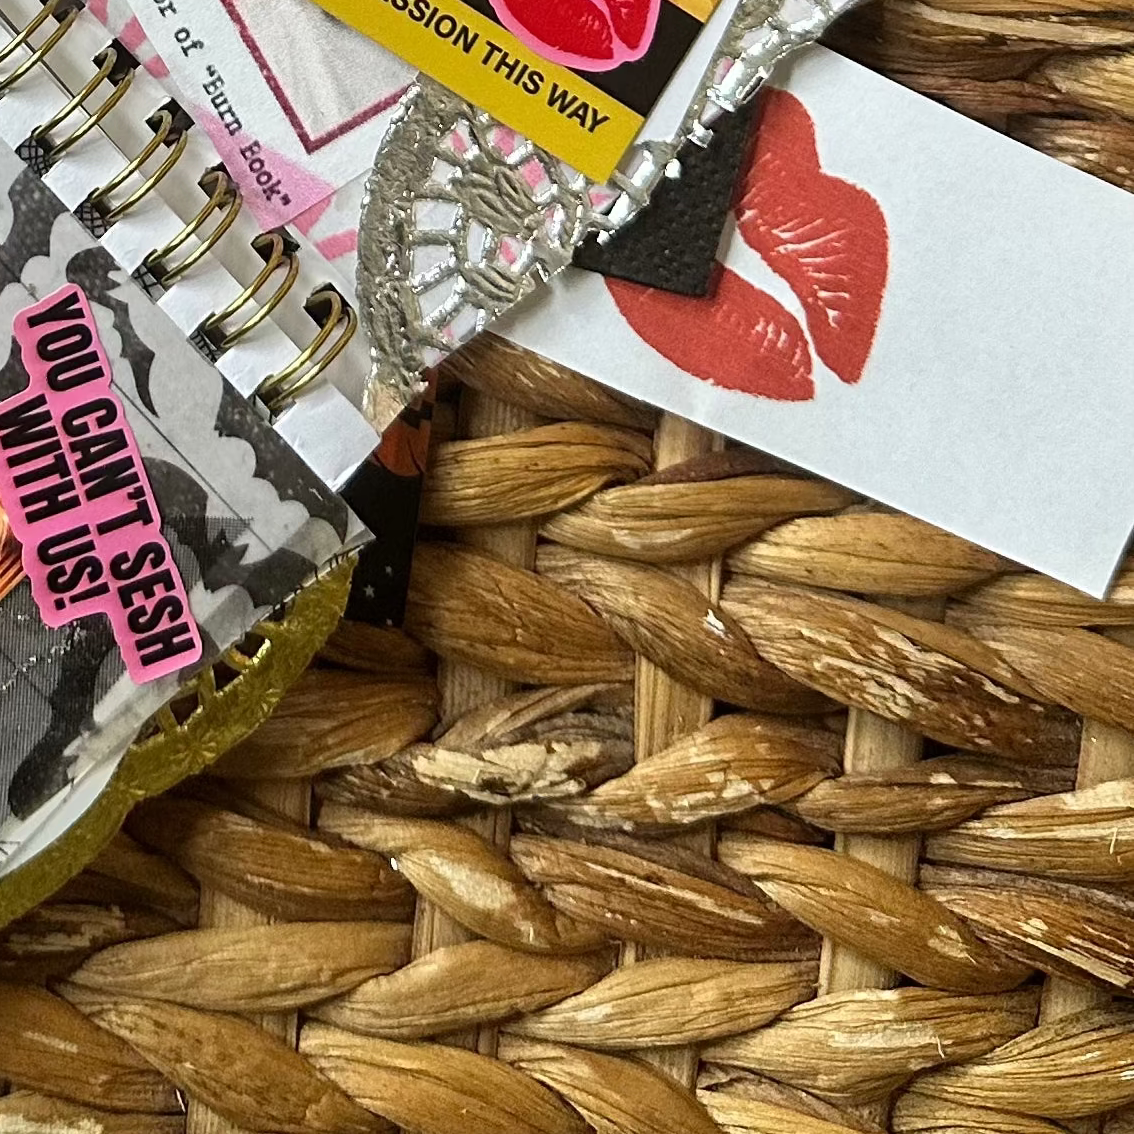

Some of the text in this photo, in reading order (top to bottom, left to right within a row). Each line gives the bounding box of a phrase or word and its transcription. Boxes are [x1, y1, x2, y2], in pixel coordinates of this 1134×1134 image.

[174, 26, 206, 58] of
[482, 39, 546, 95] THIS
[547, 84, 611, 135] WAY
[27, 292, 197, 667] YOU CAN'T SESH
[36, 523, 110, 611] US!
